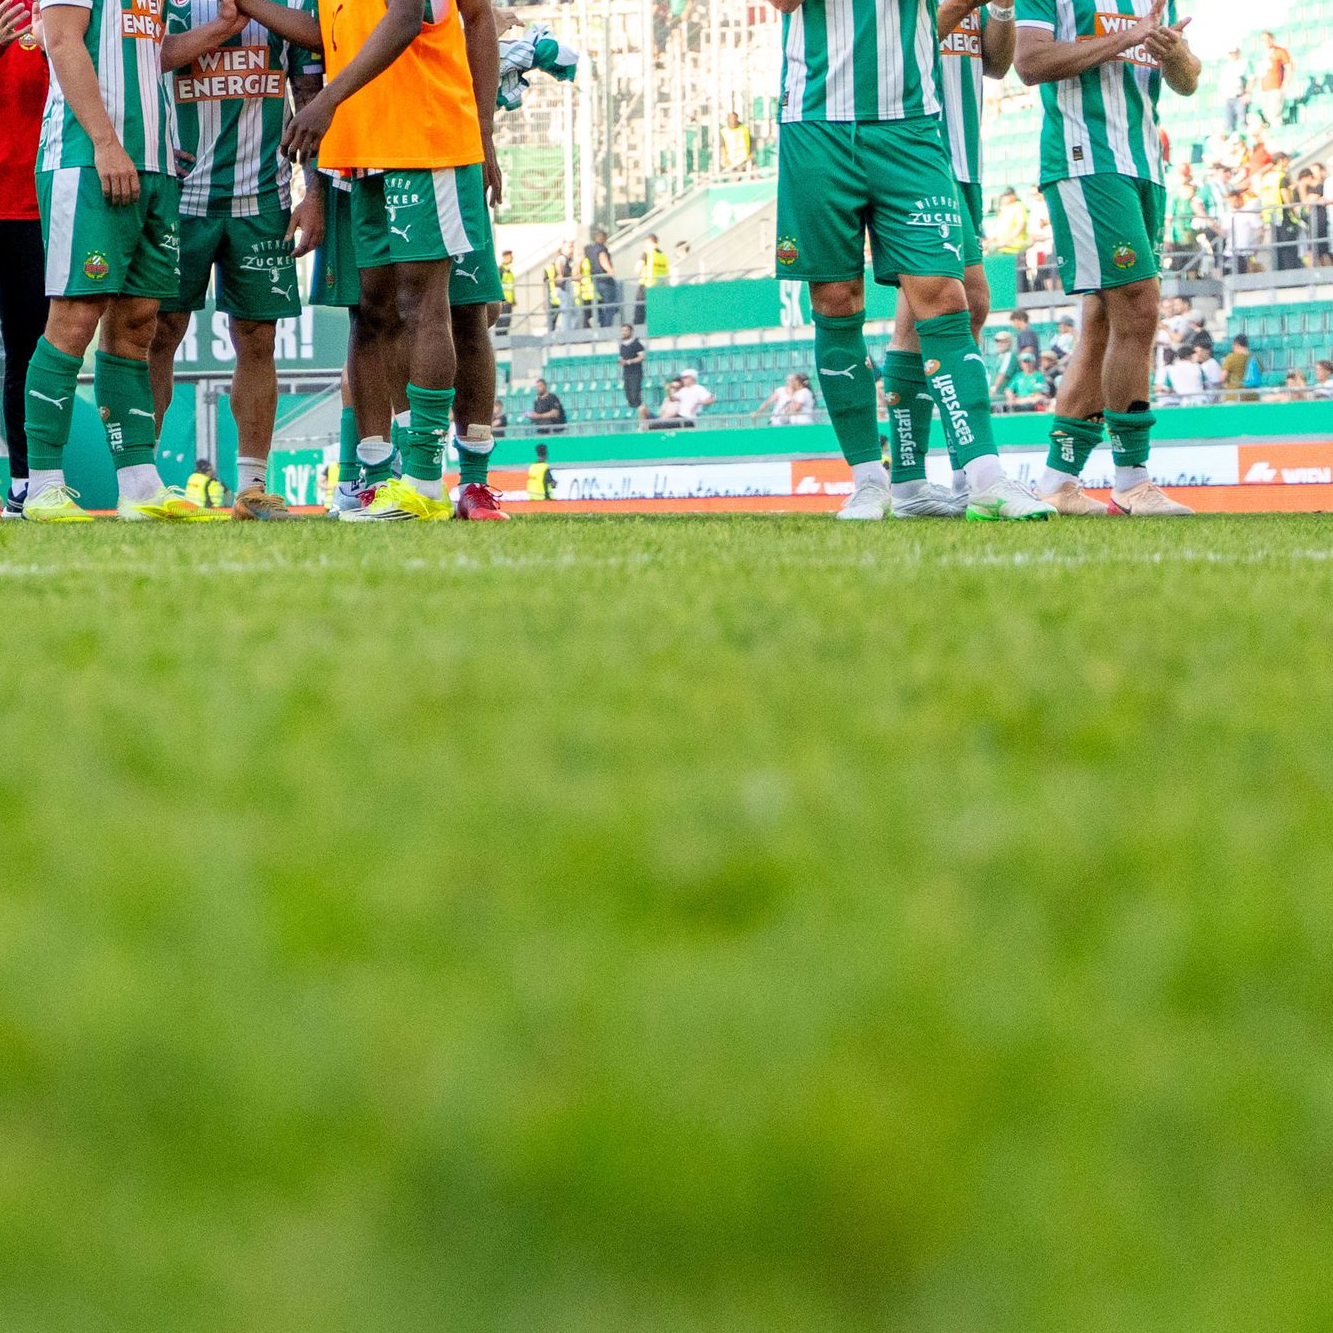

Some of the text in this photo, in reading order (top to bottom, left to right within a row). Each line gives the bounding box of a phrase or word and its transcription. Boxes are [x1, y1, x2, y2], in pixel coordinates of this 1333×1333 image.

[1099, 15, 1142, 35] WIE
[197, 49, 265, 73] WIEN
[178, 74, 281, 99] ENERGIE
[385, 193, 419, 207] CKER
[779, 279, 807, 328] SK
[934, 373, 974, 446] easystaff
[893, 408, 916, 468] easystaff
